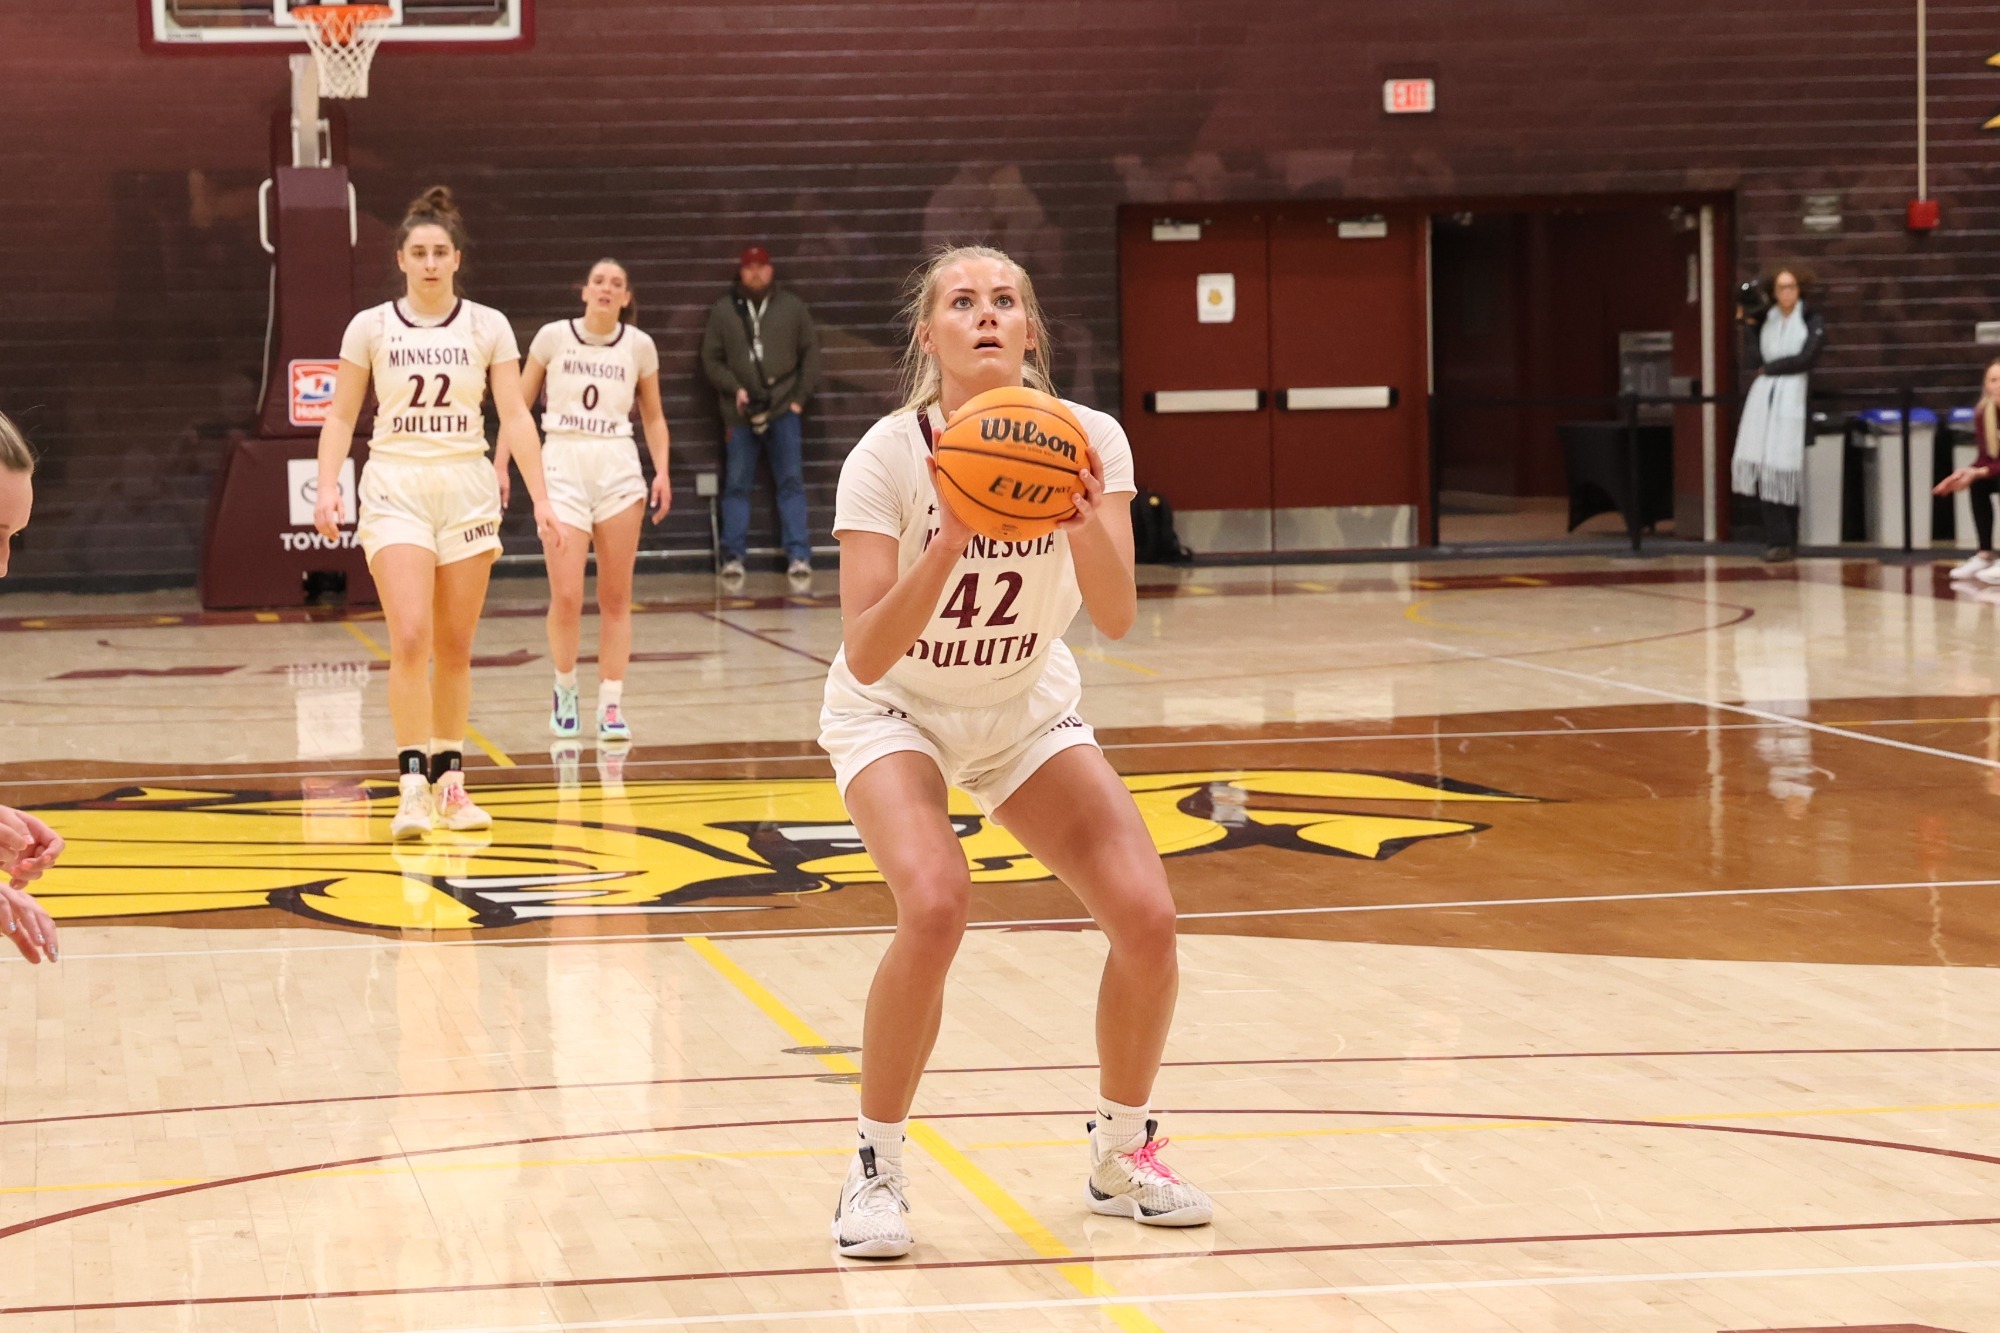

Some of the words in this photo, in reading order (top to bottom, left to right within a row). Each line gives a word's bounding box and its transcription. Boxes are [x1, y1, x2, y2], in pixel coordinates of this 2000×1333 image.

[389, 348, 469, 367] MINNESOTA
[562, 360, 625, 382] MINNESOTA
[408, 373, 451, 408] 22
[582, 384, 599, 411] 0
[392, 415, 468, 433] DULUTH
[980, 416, 1077, 463] Wilson
[939, 571, 1023, 630] 42
[905, 632, 1038, 668] DULUTH
